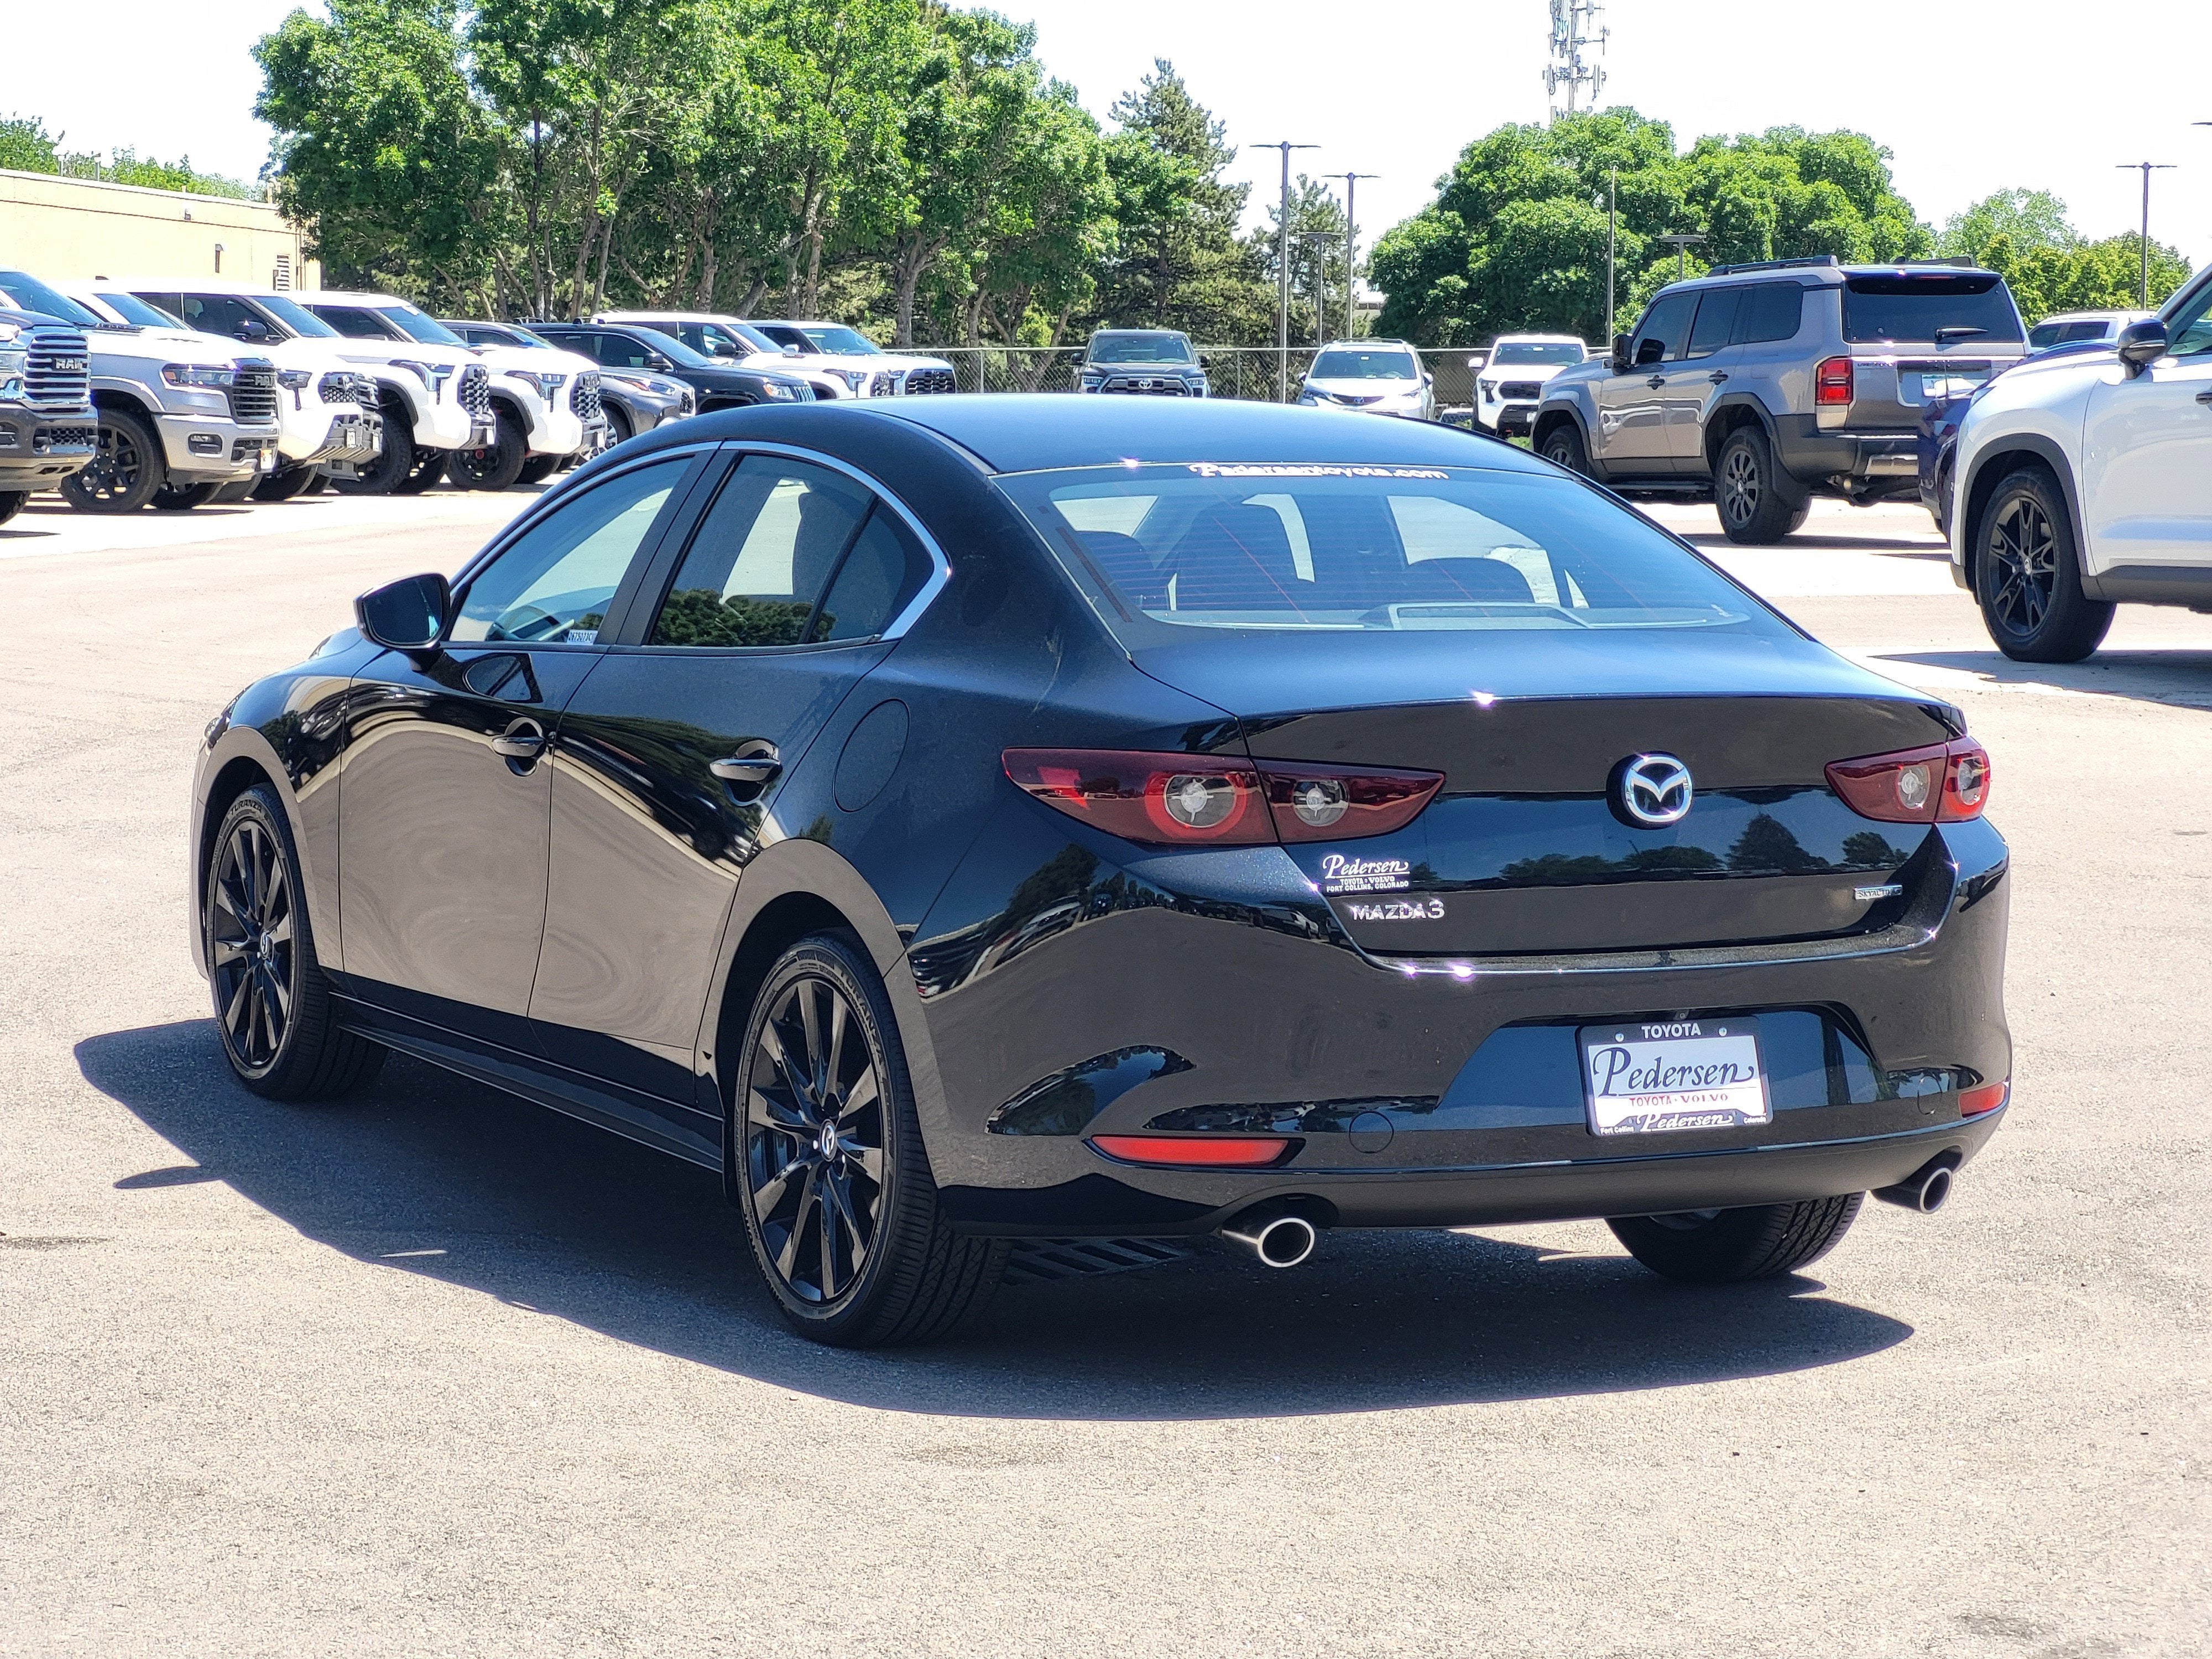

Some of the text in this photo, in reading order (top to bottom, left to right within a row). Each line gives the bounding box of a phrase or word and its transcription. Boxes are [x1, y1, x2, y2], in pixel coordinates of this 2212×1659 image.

[1322, 854, 1409, 879] Pedersen
[1339, 876, 1395, 885] TOYOTA VOLVO
[1374, 880, 1409, 890] COLORADO
[1641, 1022, 1702, 1039] TOYOTA
[1593, 1047, 1754, 1097] Pedersen
[1629, 1093, 1728, 1107] TOYOTA VOLVO
[1636, 1113, 1733, 1133] Pedersen
